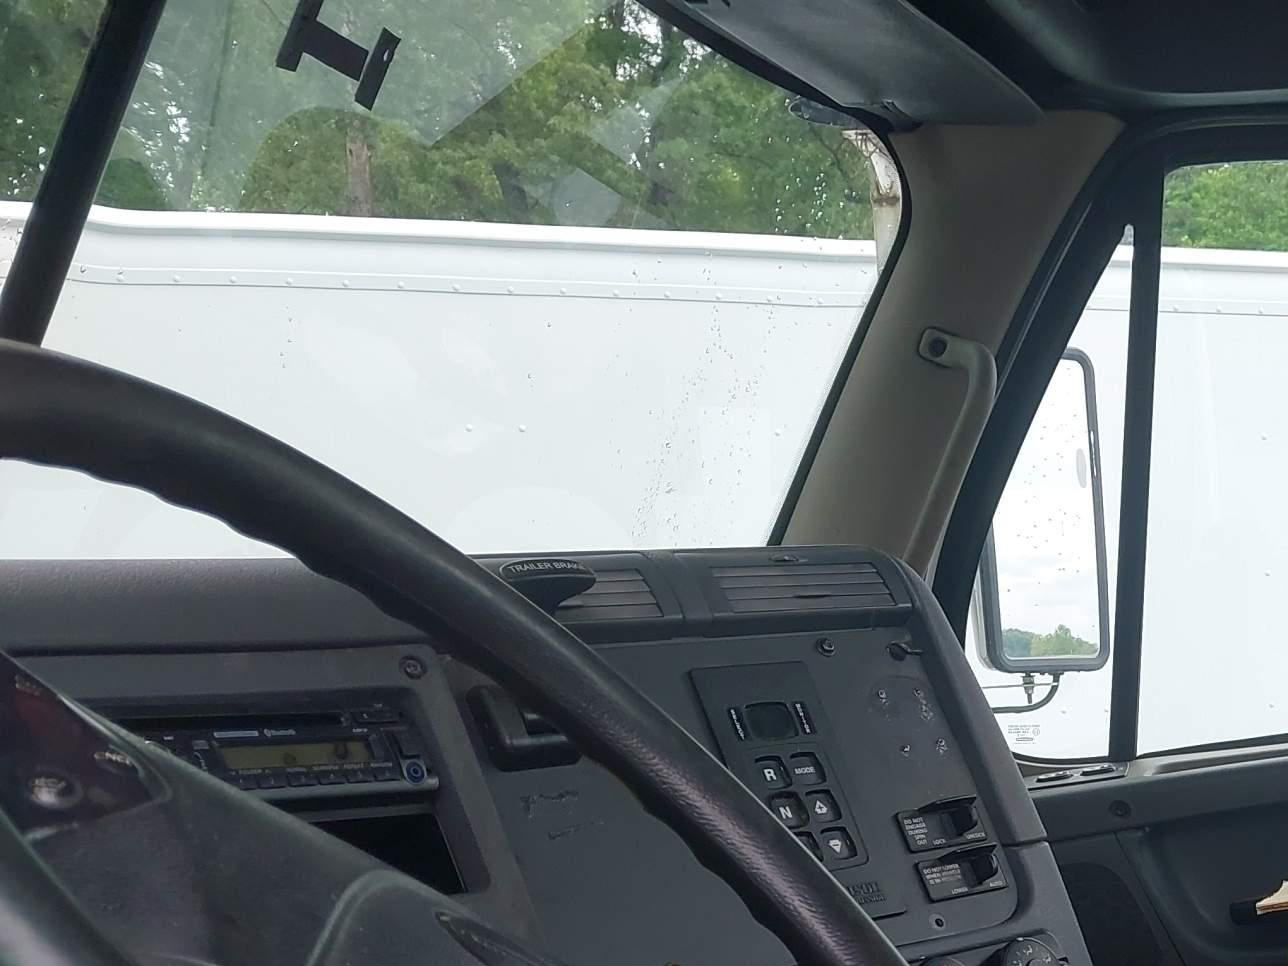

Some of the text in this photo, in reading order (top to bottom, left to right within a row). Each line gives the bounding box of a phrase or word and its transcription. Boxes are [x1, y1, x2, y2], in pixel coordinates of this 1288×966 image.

[507, 562, 552, 573] TRAILER
[763, 768, 777, 781] R
[779, 806, 793, 819] N
